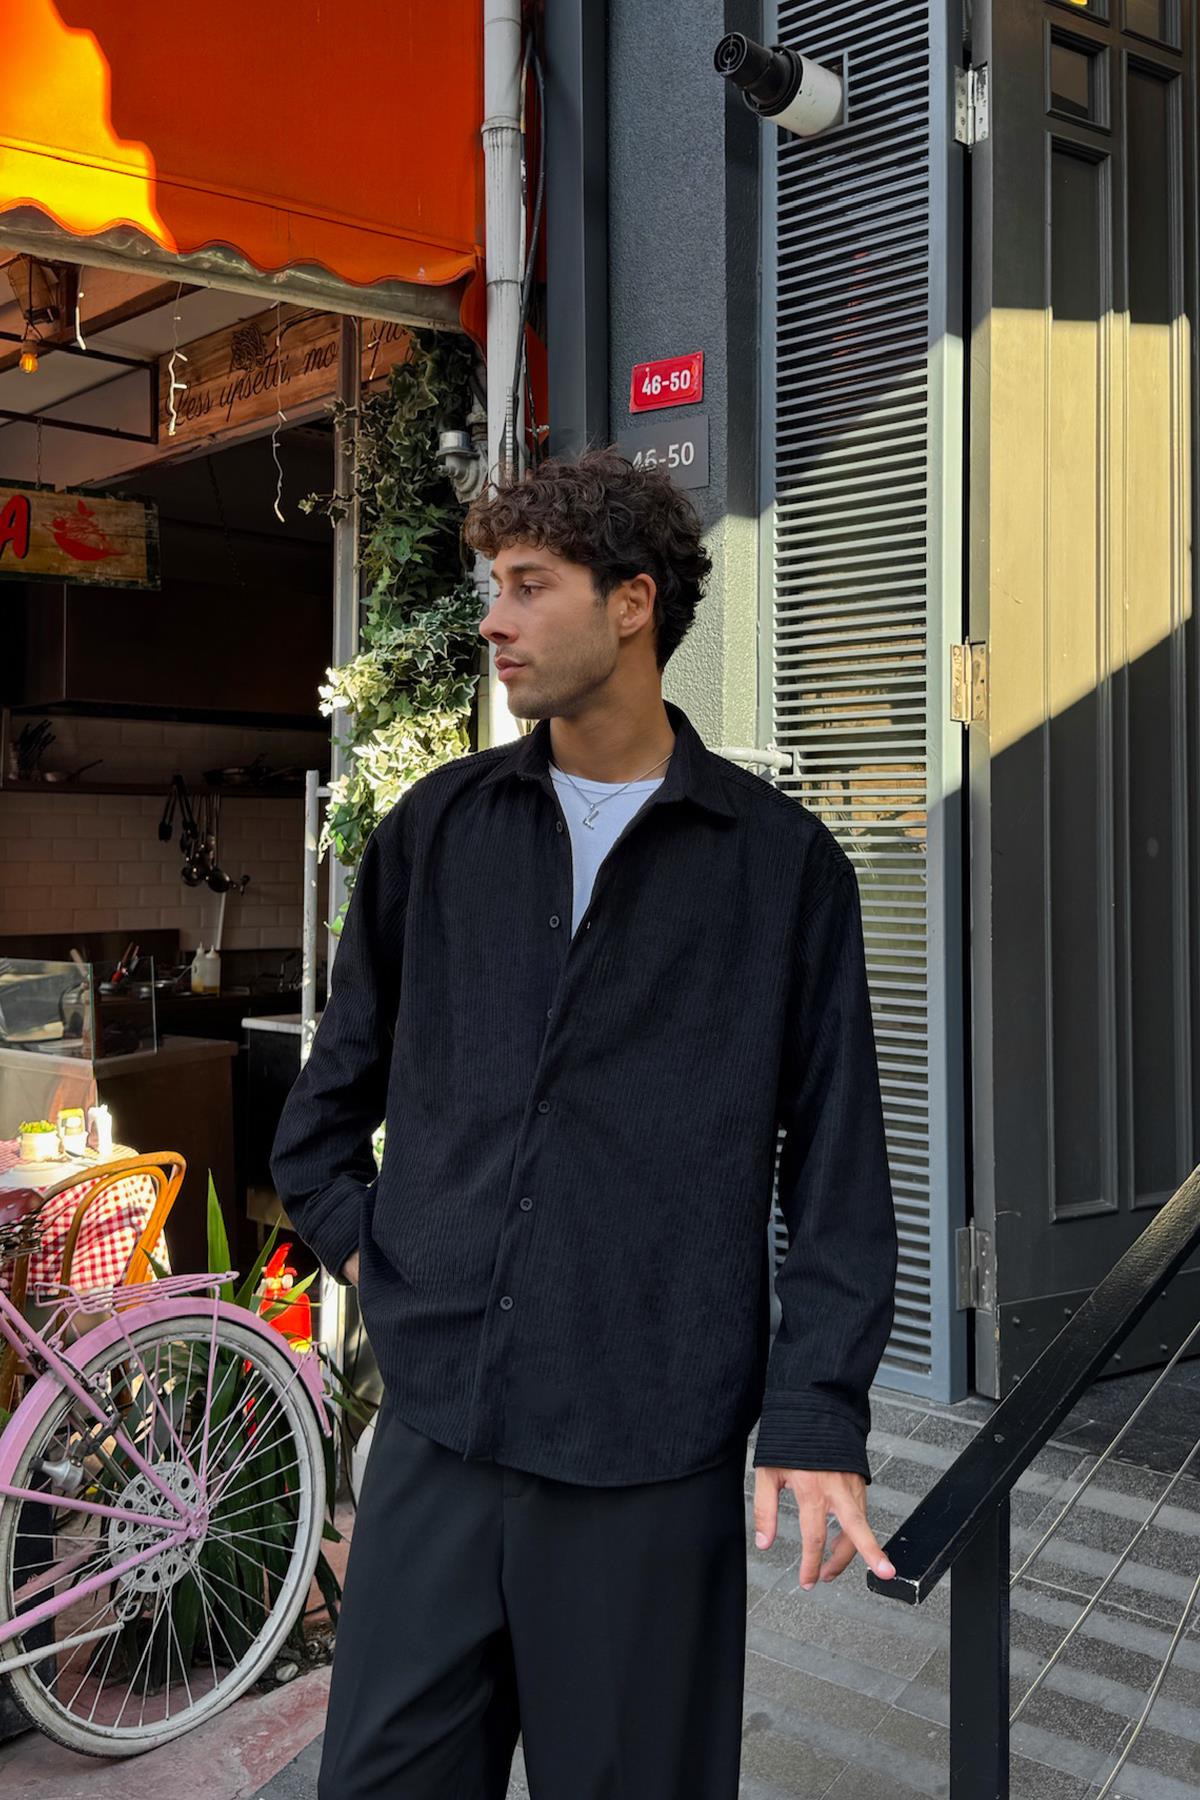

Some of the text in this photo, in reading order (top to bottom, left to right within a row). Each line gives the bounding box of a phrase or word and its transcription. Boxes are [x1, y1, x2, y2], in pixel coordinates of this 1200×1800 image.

[164, 382, 211, 429] Less
[303, 341, 338, 375] mo
[641, 369, 691, 396] 46-50
[632, 441, 694, 473] 46-50
